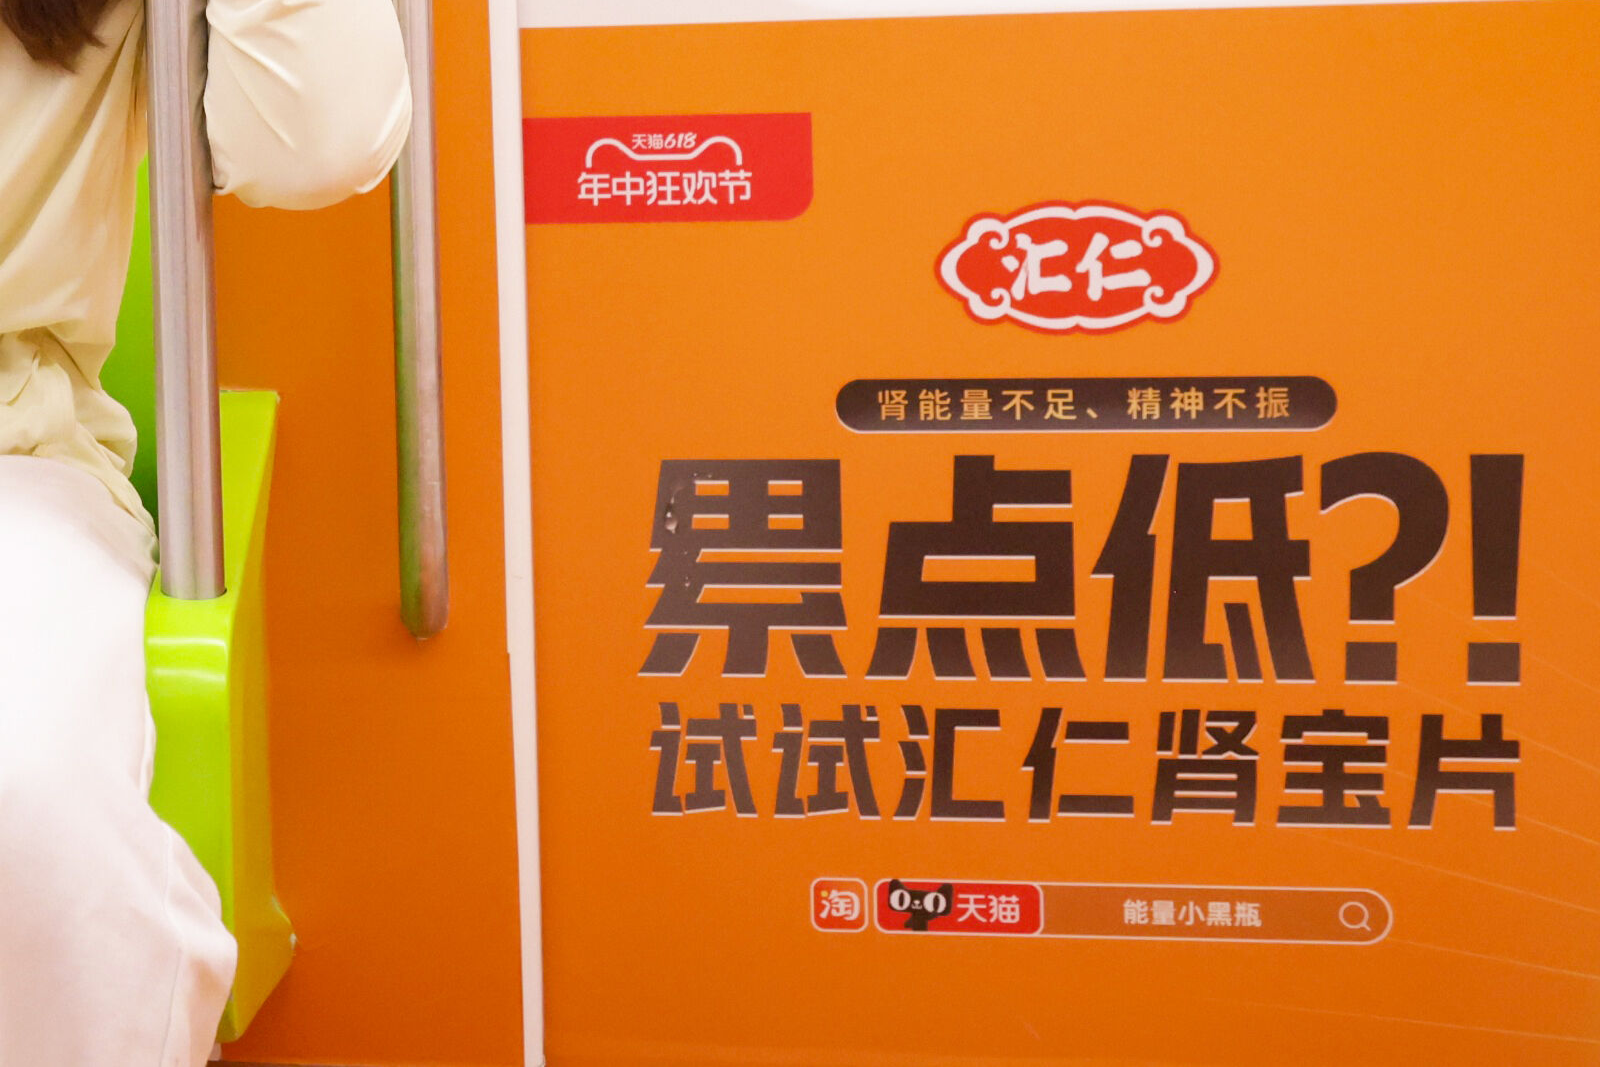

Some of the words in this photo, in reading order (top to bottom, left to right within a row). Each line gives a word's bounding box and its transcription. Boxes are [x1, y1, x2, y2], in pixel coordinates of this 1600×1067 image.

[631, 132, 698, 150] 天猫618
[577, 169, 753, 207] 年中狂欢节
[1001, 232, 1152, 302] 汇仁
[877, 386, 1292, 422] 肾能量不足、精神不振
[649, 701, 1522, 831] 试试汇仁肾宝片
[819, 889, 860, 920] 淘
[956, 893, 1021, 924] 天猫
[1122, 898, 1262, 928] 能量小黑瓶
